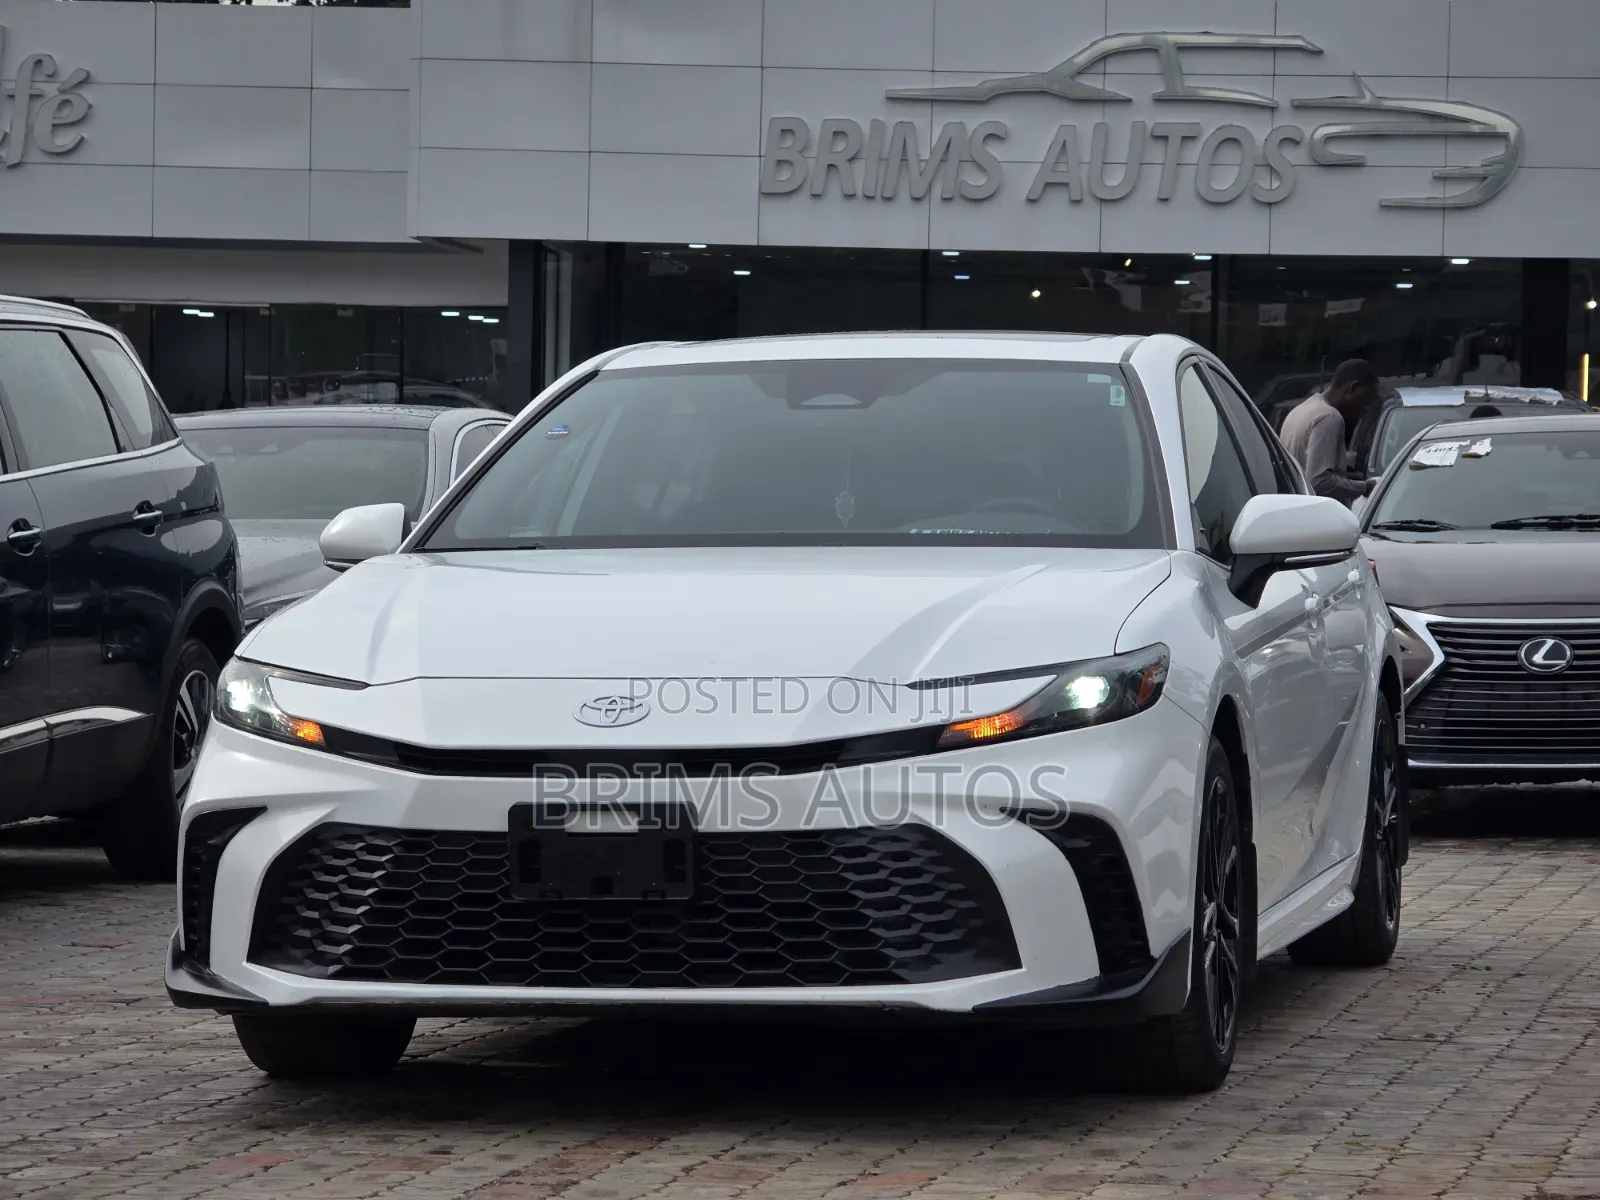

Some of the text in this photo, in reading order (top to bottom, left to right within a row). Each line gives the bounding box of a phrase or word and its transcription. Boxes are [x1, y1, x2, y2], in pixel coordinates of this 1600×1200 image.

[0, 53, 92, 169] fé
[760, 116, 1304, 203] BRIMS AUTOS
